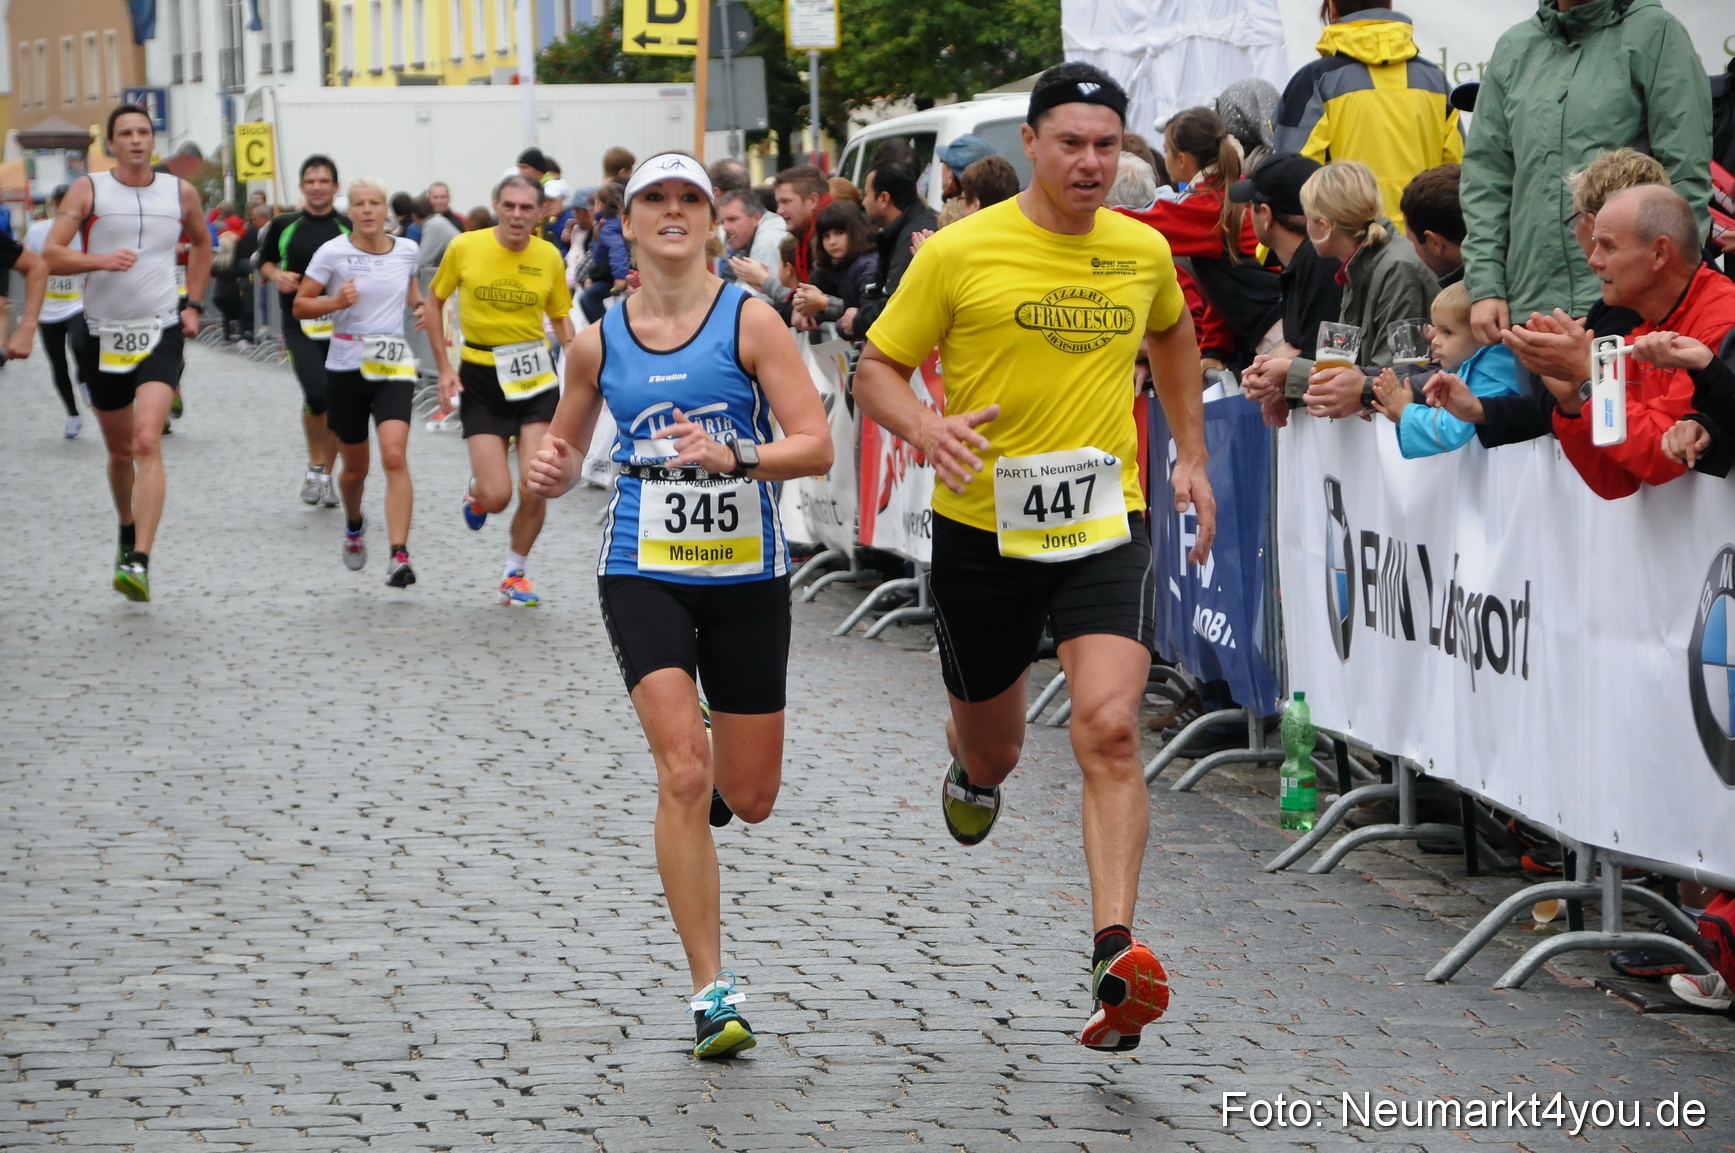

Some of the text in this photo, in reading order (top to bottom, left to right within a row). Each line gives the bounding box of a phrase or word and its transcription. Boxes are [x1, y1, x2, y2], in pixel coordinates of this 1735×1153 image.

[245, 139, 265, 167] C
[50, 278, 72, 290] 248
[481, 288, 532, 303] FRANCESCO
[1045, 288, 1110, 308] PIZZERIA
[1033, 305, 1125, 329] FRANCESCO
[113, 332, 150, 352] 289
[374, 341, 405, 361] 287
[1047, 331, 1111, 352] HERSBRUCK
[510, 352, 541, 377] 451
[996, 458, 1099, 478] PARTL Neumarkt
[1023, 473, 1097, 523] 447
[664, 491, 739, 534] 345
[1042, 531, 1087, 549] Jorge
[669, 545, 734, 561] Melanie
